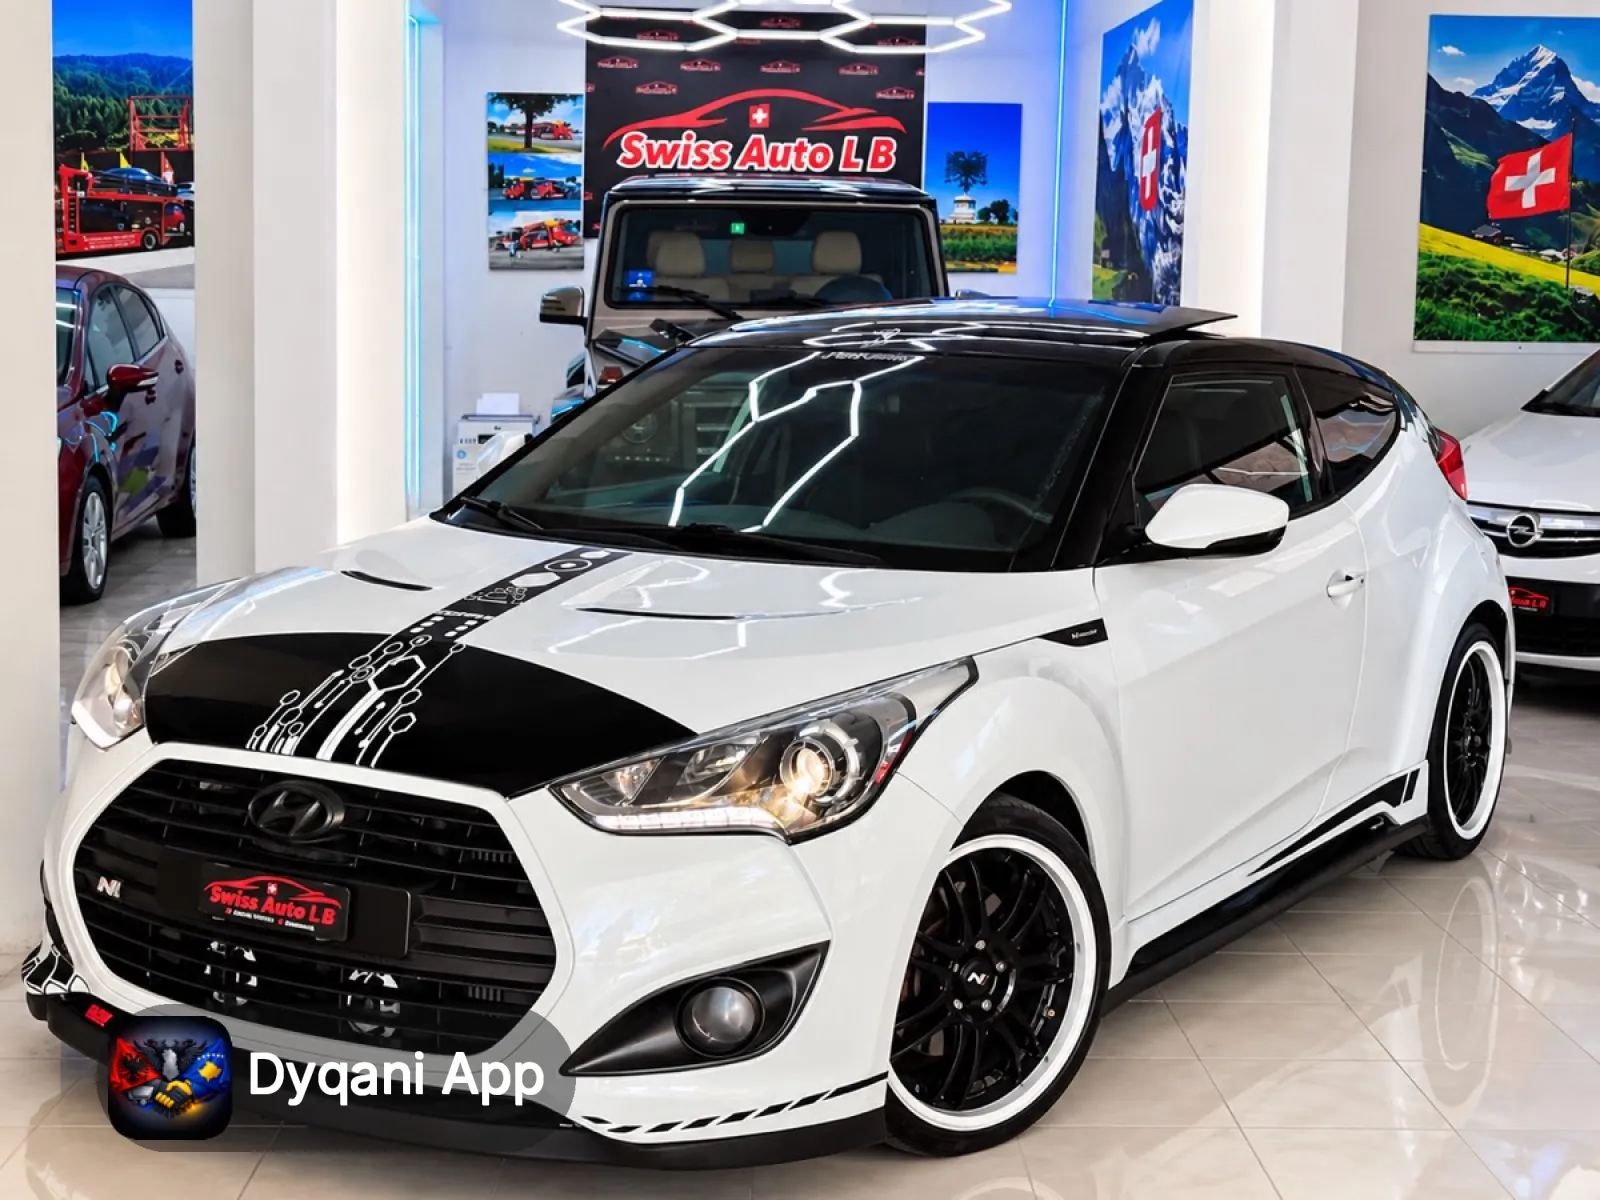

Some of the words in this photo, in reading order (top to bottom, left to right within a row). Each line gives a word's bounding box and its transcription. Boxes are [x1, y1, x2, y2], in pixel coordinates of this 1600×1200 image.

[617, 130, 732, 169] Swiss
[738, 133, 833, 171] Auto
[210, 886, 258, 910] Swiss
[261, 896, 305, 918] Auto
